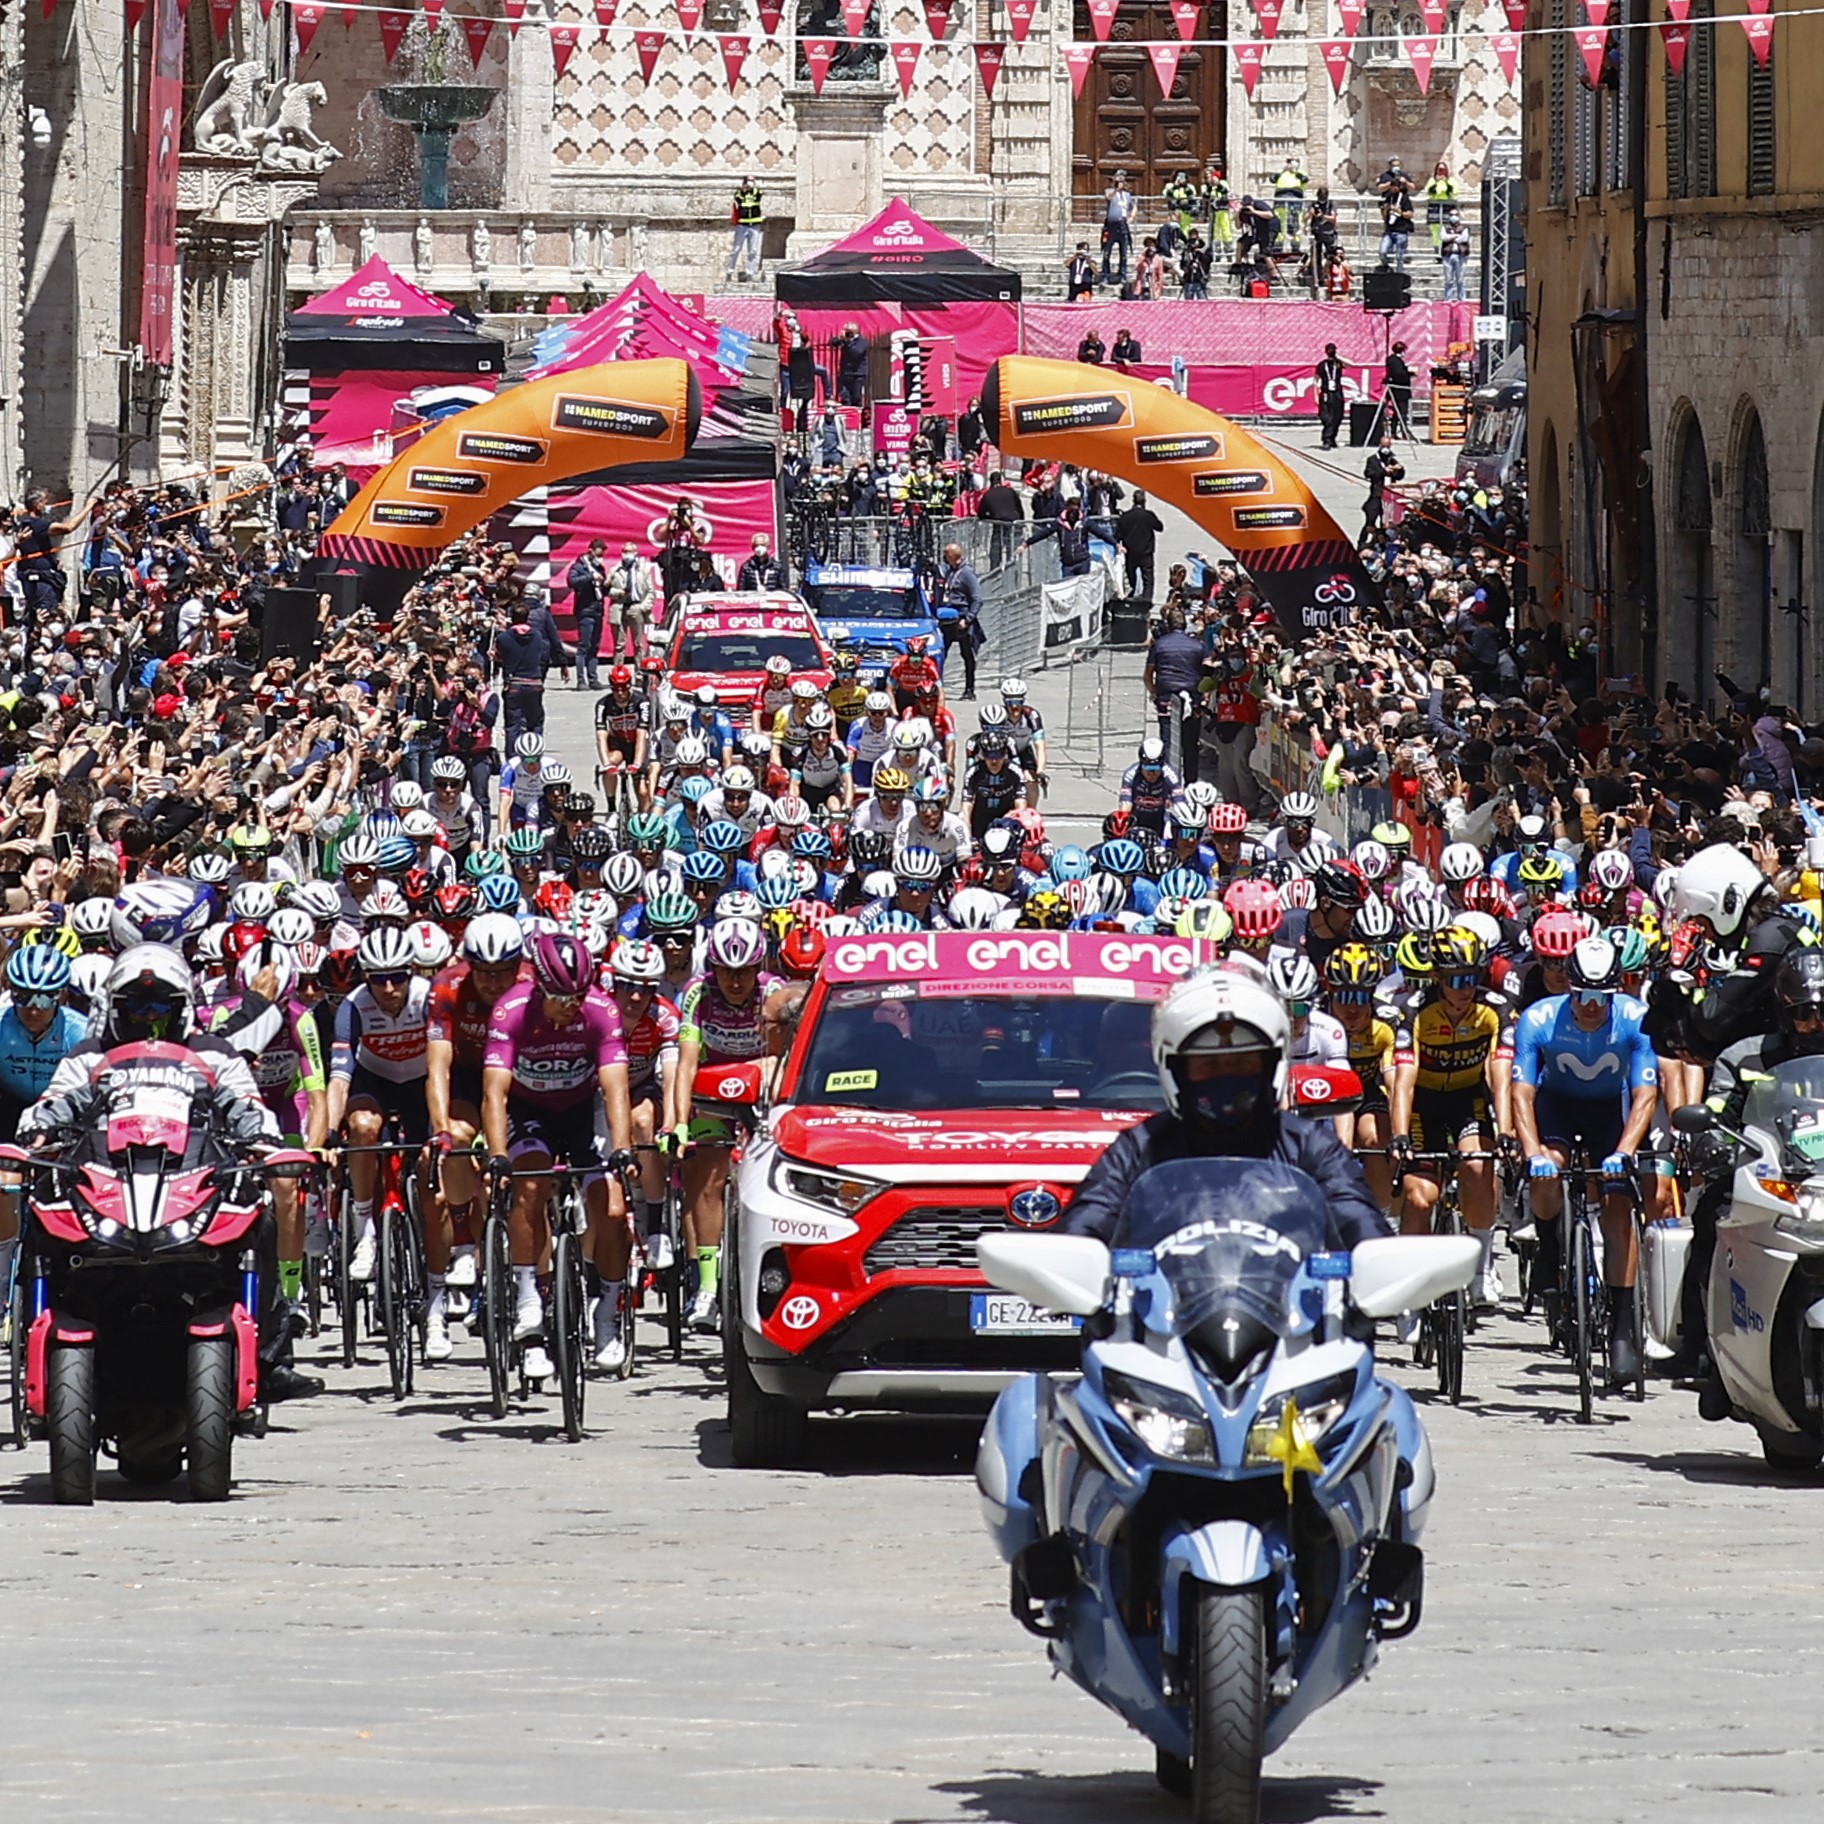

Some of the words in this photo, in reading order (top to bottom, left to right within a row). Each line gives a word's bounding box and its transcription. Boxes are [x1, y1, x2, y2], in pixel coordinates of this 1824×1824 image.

[872, 235, 893, 246] Giro
[346, 297, 367, 308] Giro
[576, 405, 653, 426] NAMEDSPORT
[1034, 403, 1110, 420] NAMEDSPORT
[474, 439, 533, 454] NAMEDSPORT
[1151, 440, 1207, 453] NAMEDSPORT
[422, 474, 474, 486] NAMEDSPORT
[685, 614, 720, 630] enel
[729, 613, 764, 629] enel
[773, 614, 807, 629] enel
[859, 901, 883, 925] ENIX
[835, 938, 938, 973] enel
[967, 938, 1071, 972] enel
[1100, 938, 1202, 975] enel
[925, 982, 1009, 993] DIREZIONE
[1012, 980, 1071, 992] CORSA
[518, 1054, 588, 1071] BORA
[129, 1068, 195, 1094] YAMAHA
[832, 1074, 872, 1087] RACE
[1798, 1137, 1810, 1146] TV
[771, 1219, 828, 1239] TOYOTA
[1154, 1219, 1301, 1262] POLIZIA
[989, 1302, 1009, 1324] GE
